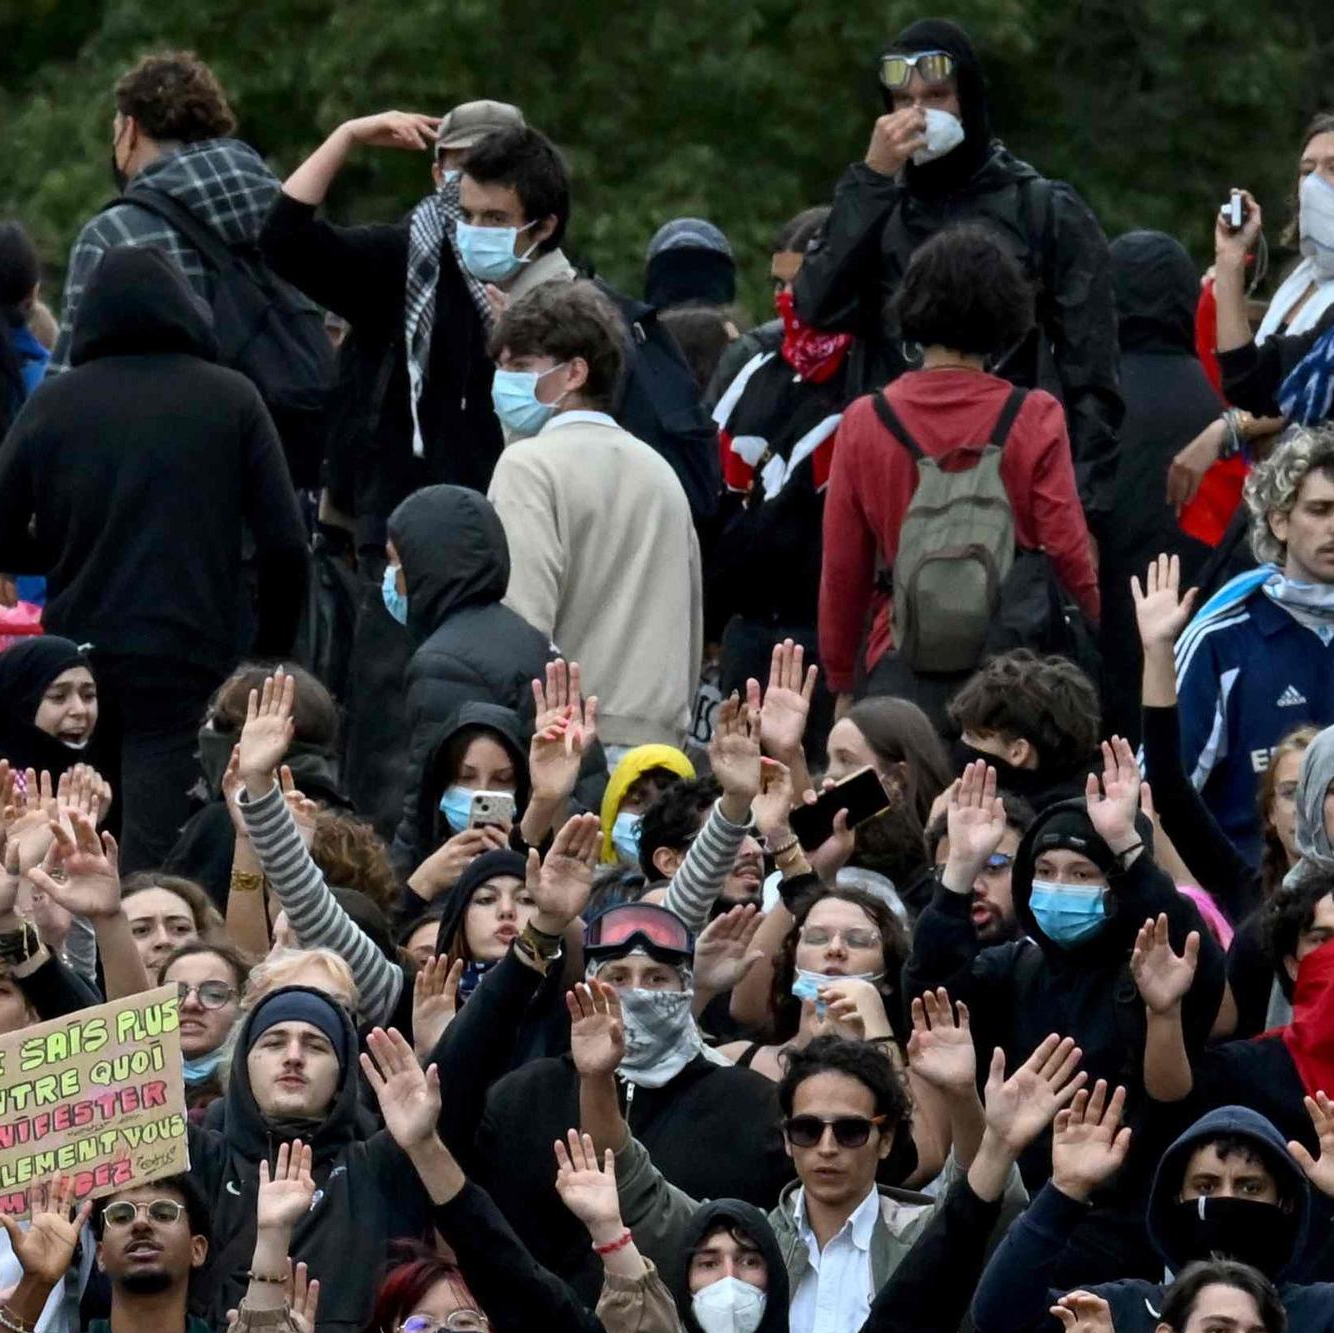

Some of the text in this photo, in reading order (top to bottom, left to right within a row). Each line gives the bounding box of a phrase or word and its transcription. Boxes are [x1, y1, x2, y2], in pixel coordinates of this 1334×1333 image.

[19, 1017, 110, 1072] SAIS
[116, 998, 180, 1045] PLUS
[89, 1040, 165, 1087] QUOI
[116, 1112, 185, 1151] VOUS
